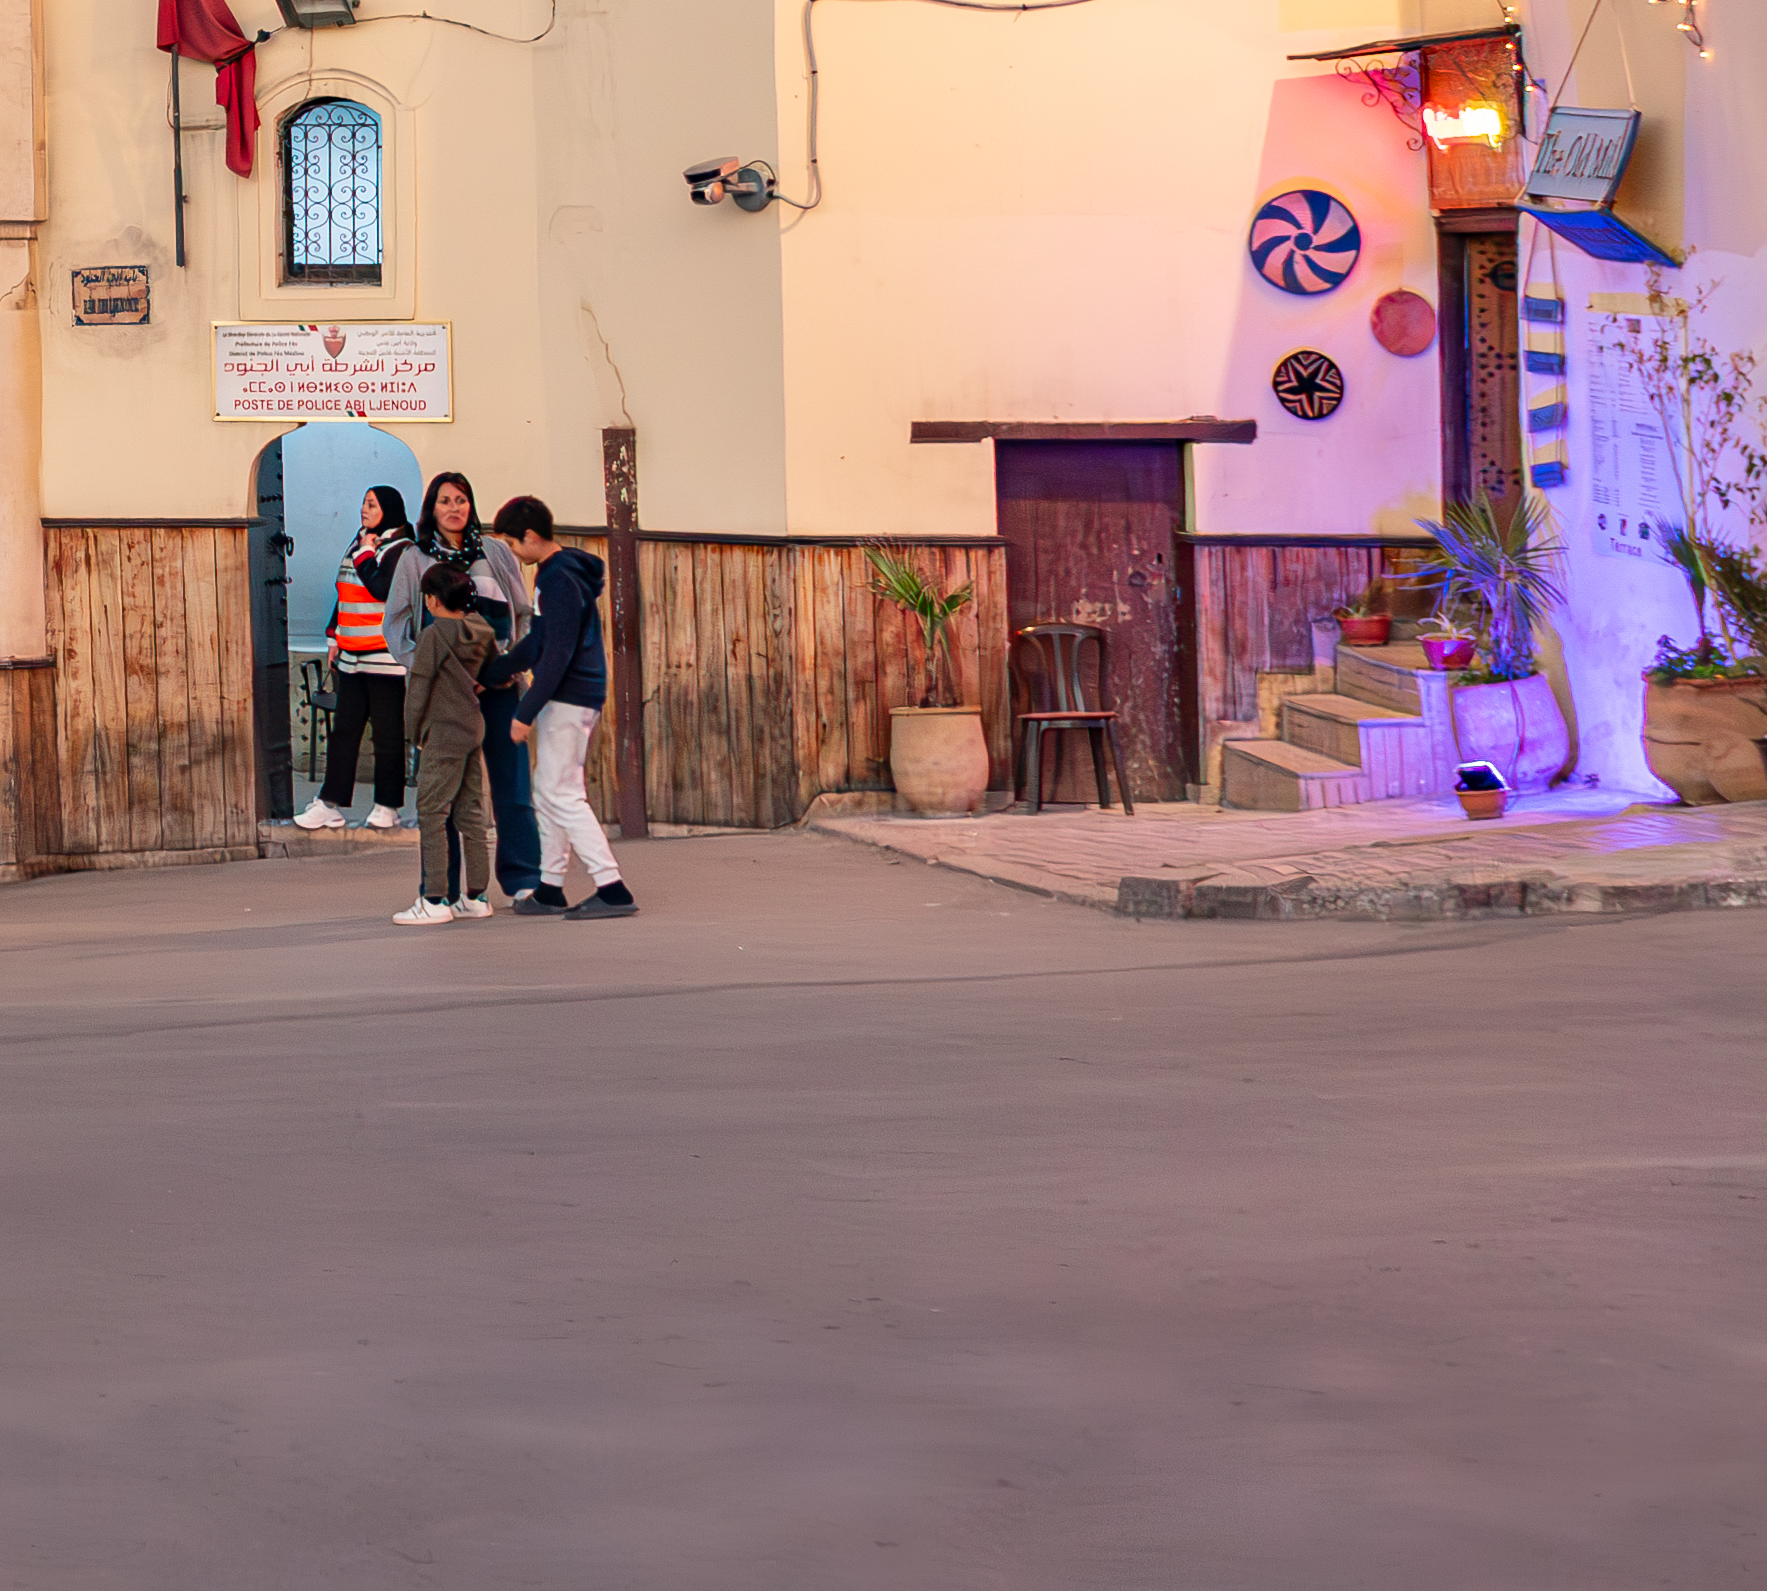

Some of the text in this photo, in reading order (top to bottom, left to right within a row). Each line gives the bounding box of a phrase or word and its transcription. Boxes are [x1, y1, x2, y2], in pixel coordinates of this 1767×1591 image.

[1535, 130, 1564, 176] The
[224, 355, 436, 377] مركز الشرطة أبي الجنود
[234, 399, 427, 411] POSTE DE POLICE ABI LJENOUD
